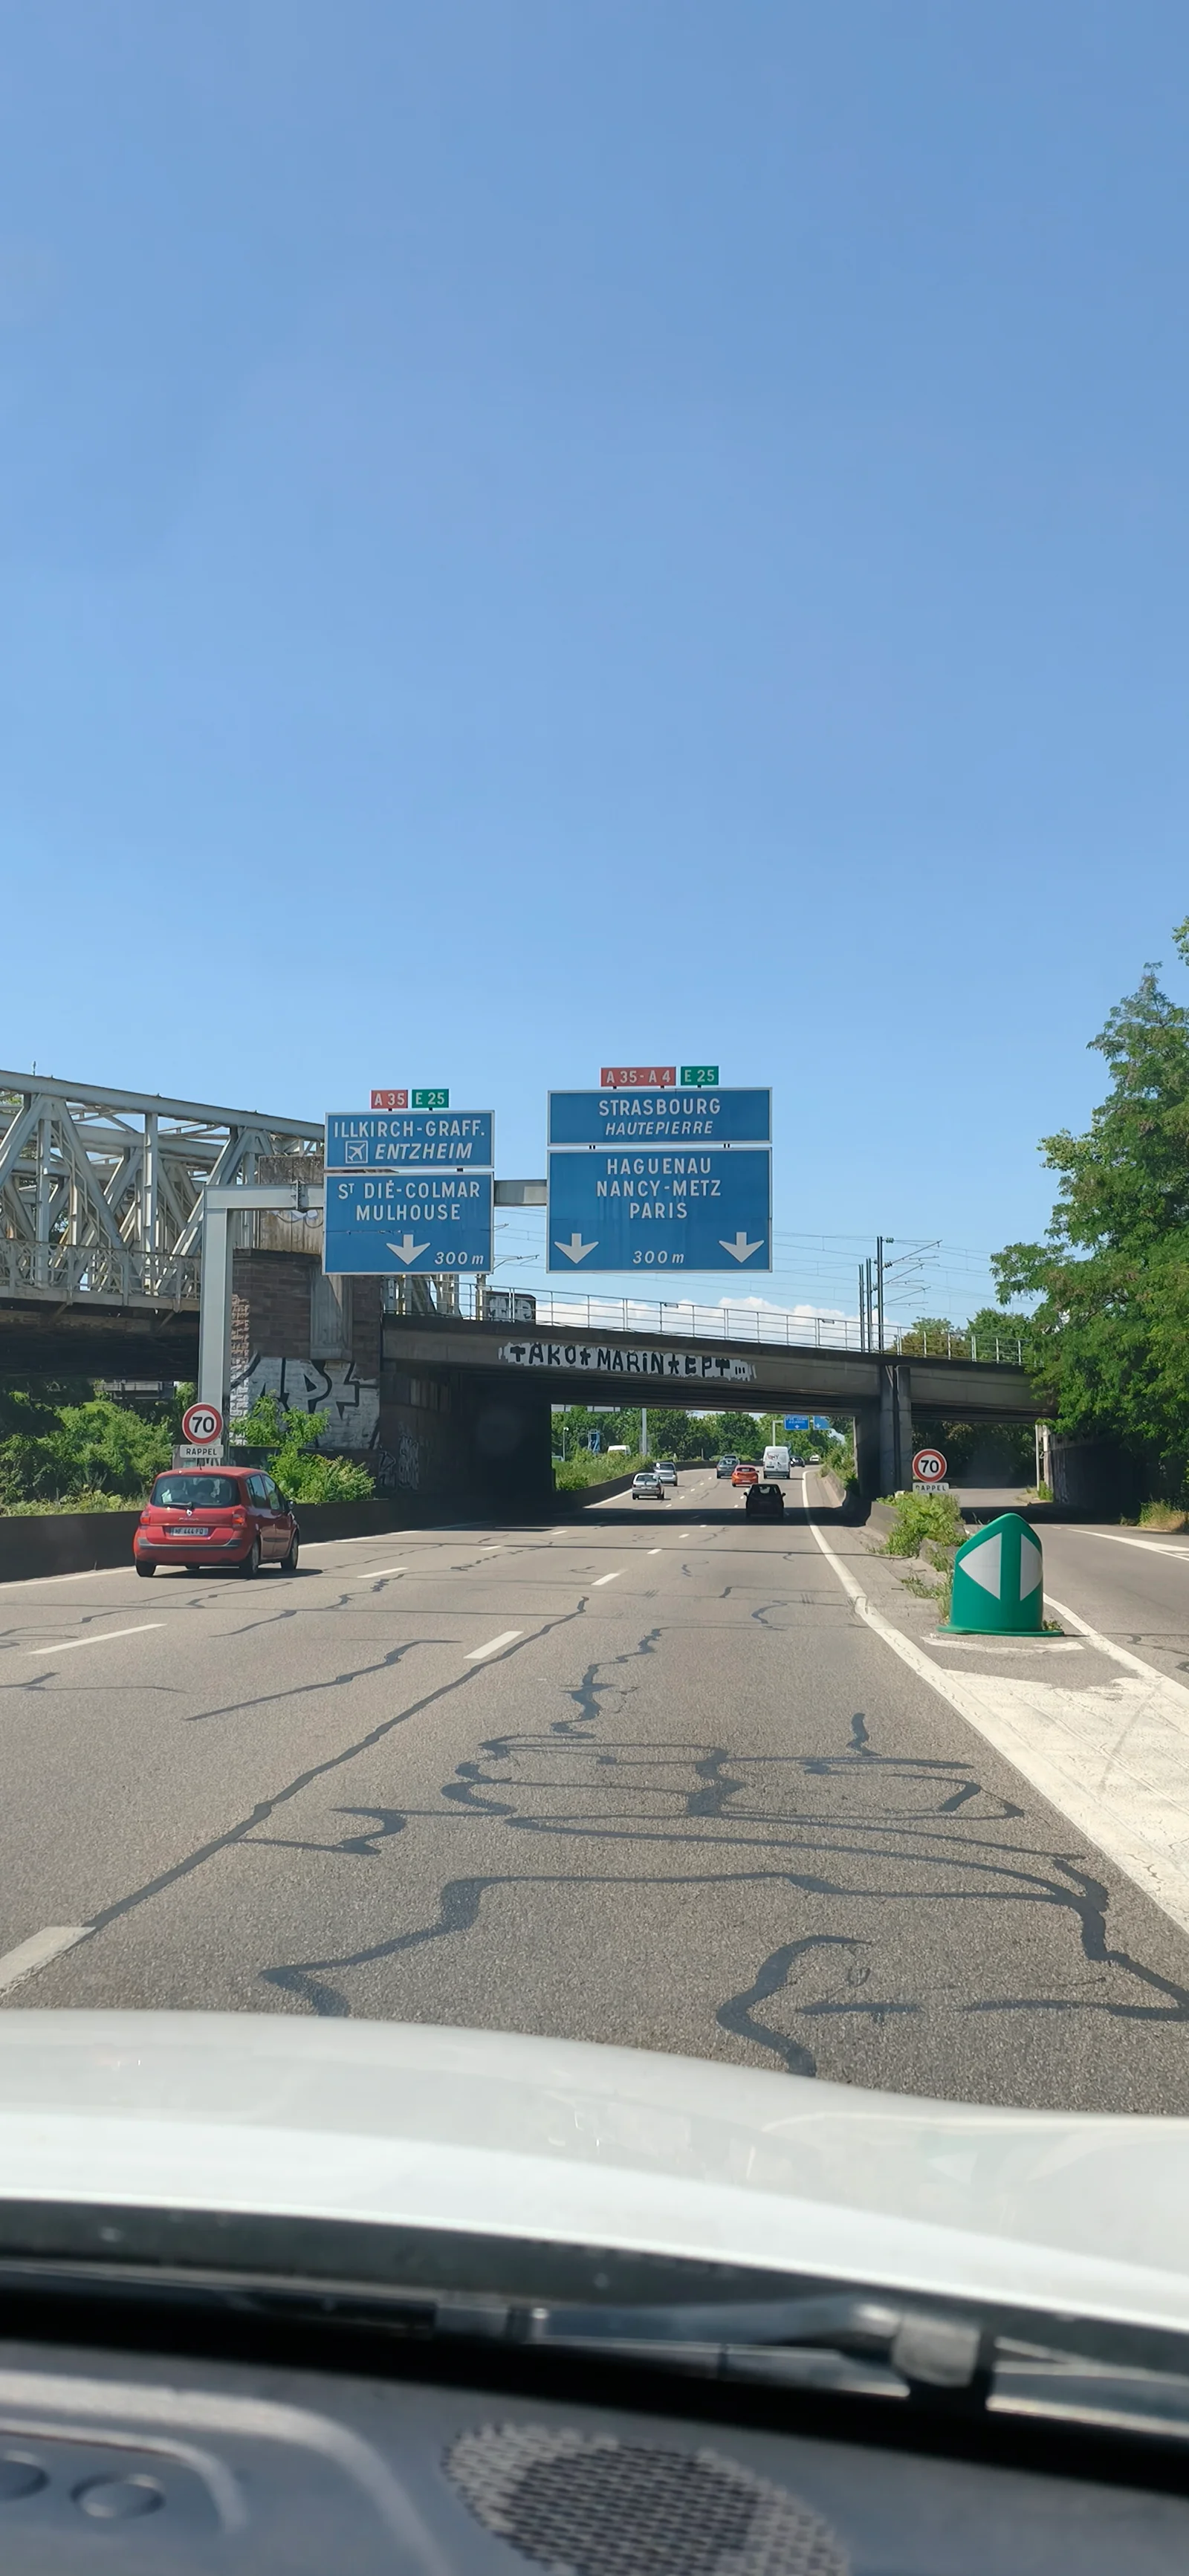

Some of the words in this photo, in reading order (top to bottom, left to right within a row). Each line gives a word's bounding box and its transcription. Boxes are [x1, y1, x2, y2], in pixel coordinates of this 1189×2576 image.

[606, 1070, 615, 1083] A
[662, 1069, 671, 1083] 4
[684, 1069, 692, 1082] E
[697, 1069, 715, 1082] 25
[374, 1092, 383, 1106] A
[387, 1092, 405, 1106] 35
[415, 1092, 423, 1105] E
[427, 1091, 445, 1105] 25
[598, 1097, 721, 1116] STRASBOURG
[334, 1120, 485, 1138] ILLKIRCH-GRAFF.
[605, 1120, 713, 1136] HAUTEPIERRE
[375, 1142, 473, 1160] ENTZHEIM
[606, 1157, 711, 1175] HAGUENAU
[364, 1180, 480, 1199] DIÉ-COLMAR
[596, 1179, 722, 1198] NANCY-METZ
[356, 1204, 461, 1221] MULHOUSE
[629, 1202, 688, 1219] PARIS
[434, 1251, 468, 1265] 300
[471, 1255, 484, 1265] m
[632, 1250, 668, 1264] 300
[671, 1253, 684, 1264] m
[192, 1416, 215, 1433] 70
[921, 1460, 939, 1473] 70
